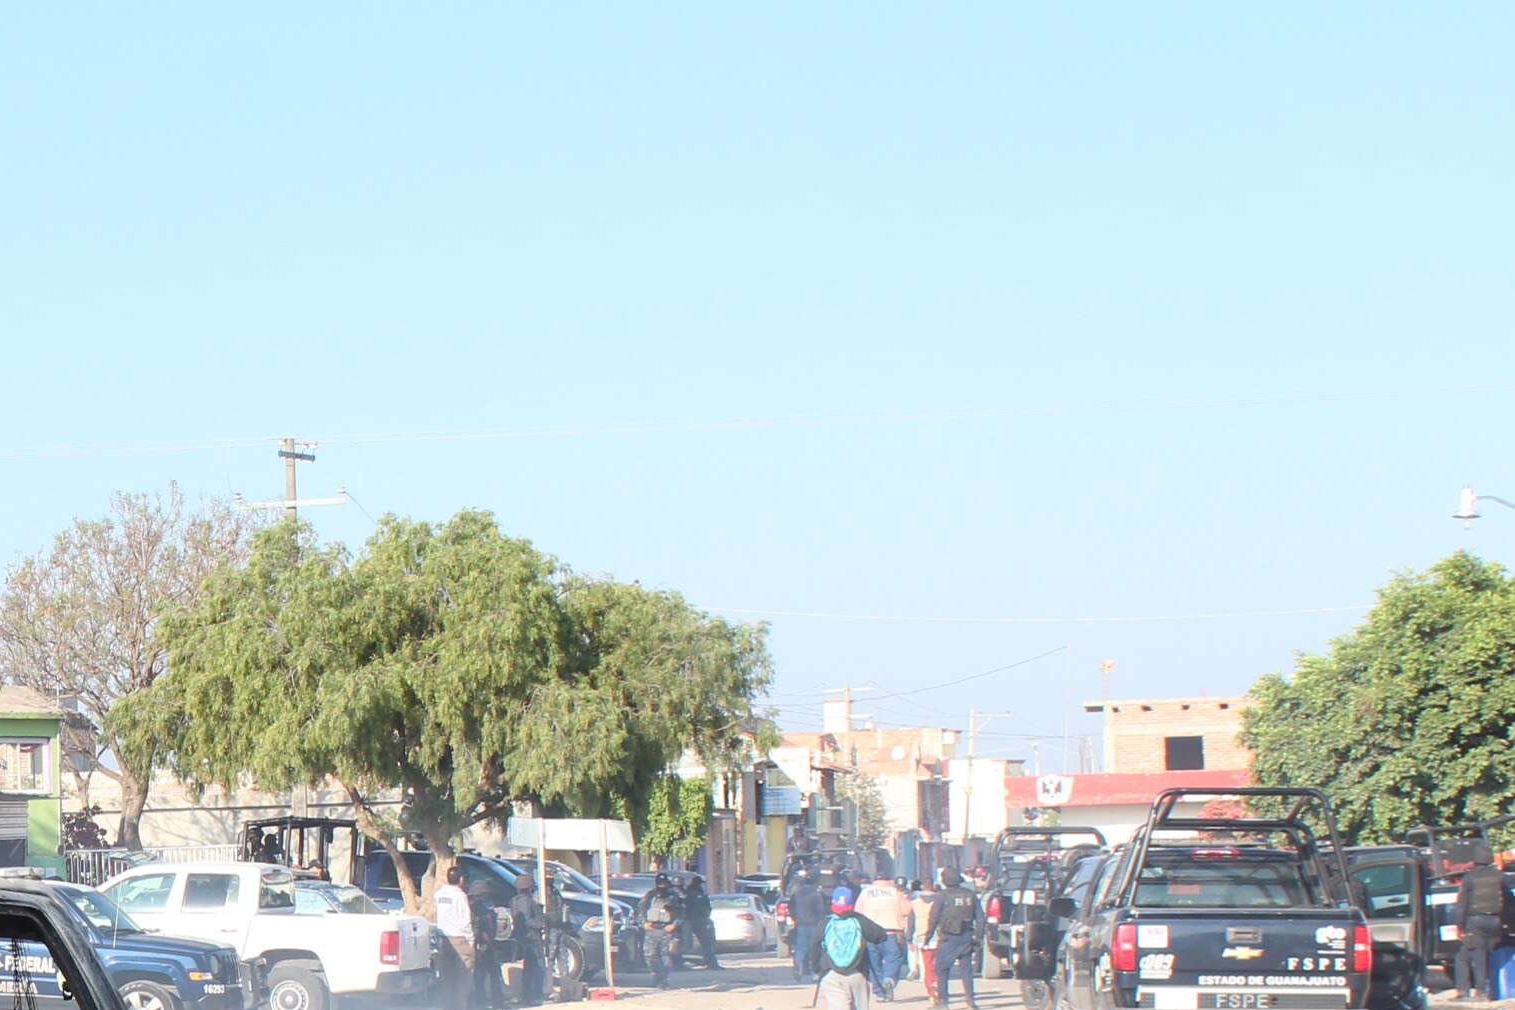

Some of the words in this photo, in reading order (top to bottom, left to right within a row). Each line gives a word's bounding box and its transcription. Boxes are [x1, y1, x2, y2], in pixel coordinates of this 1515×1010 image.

[1287, 957, 1347, 971] FSPE
[1198, 976, 1246, 985] ESTADO
[1247, 976, 1263, 985] DE
[1265, 976, 1347, 986] GUANAJUATO
[1216, 993, 1269, 1008] FSPE
